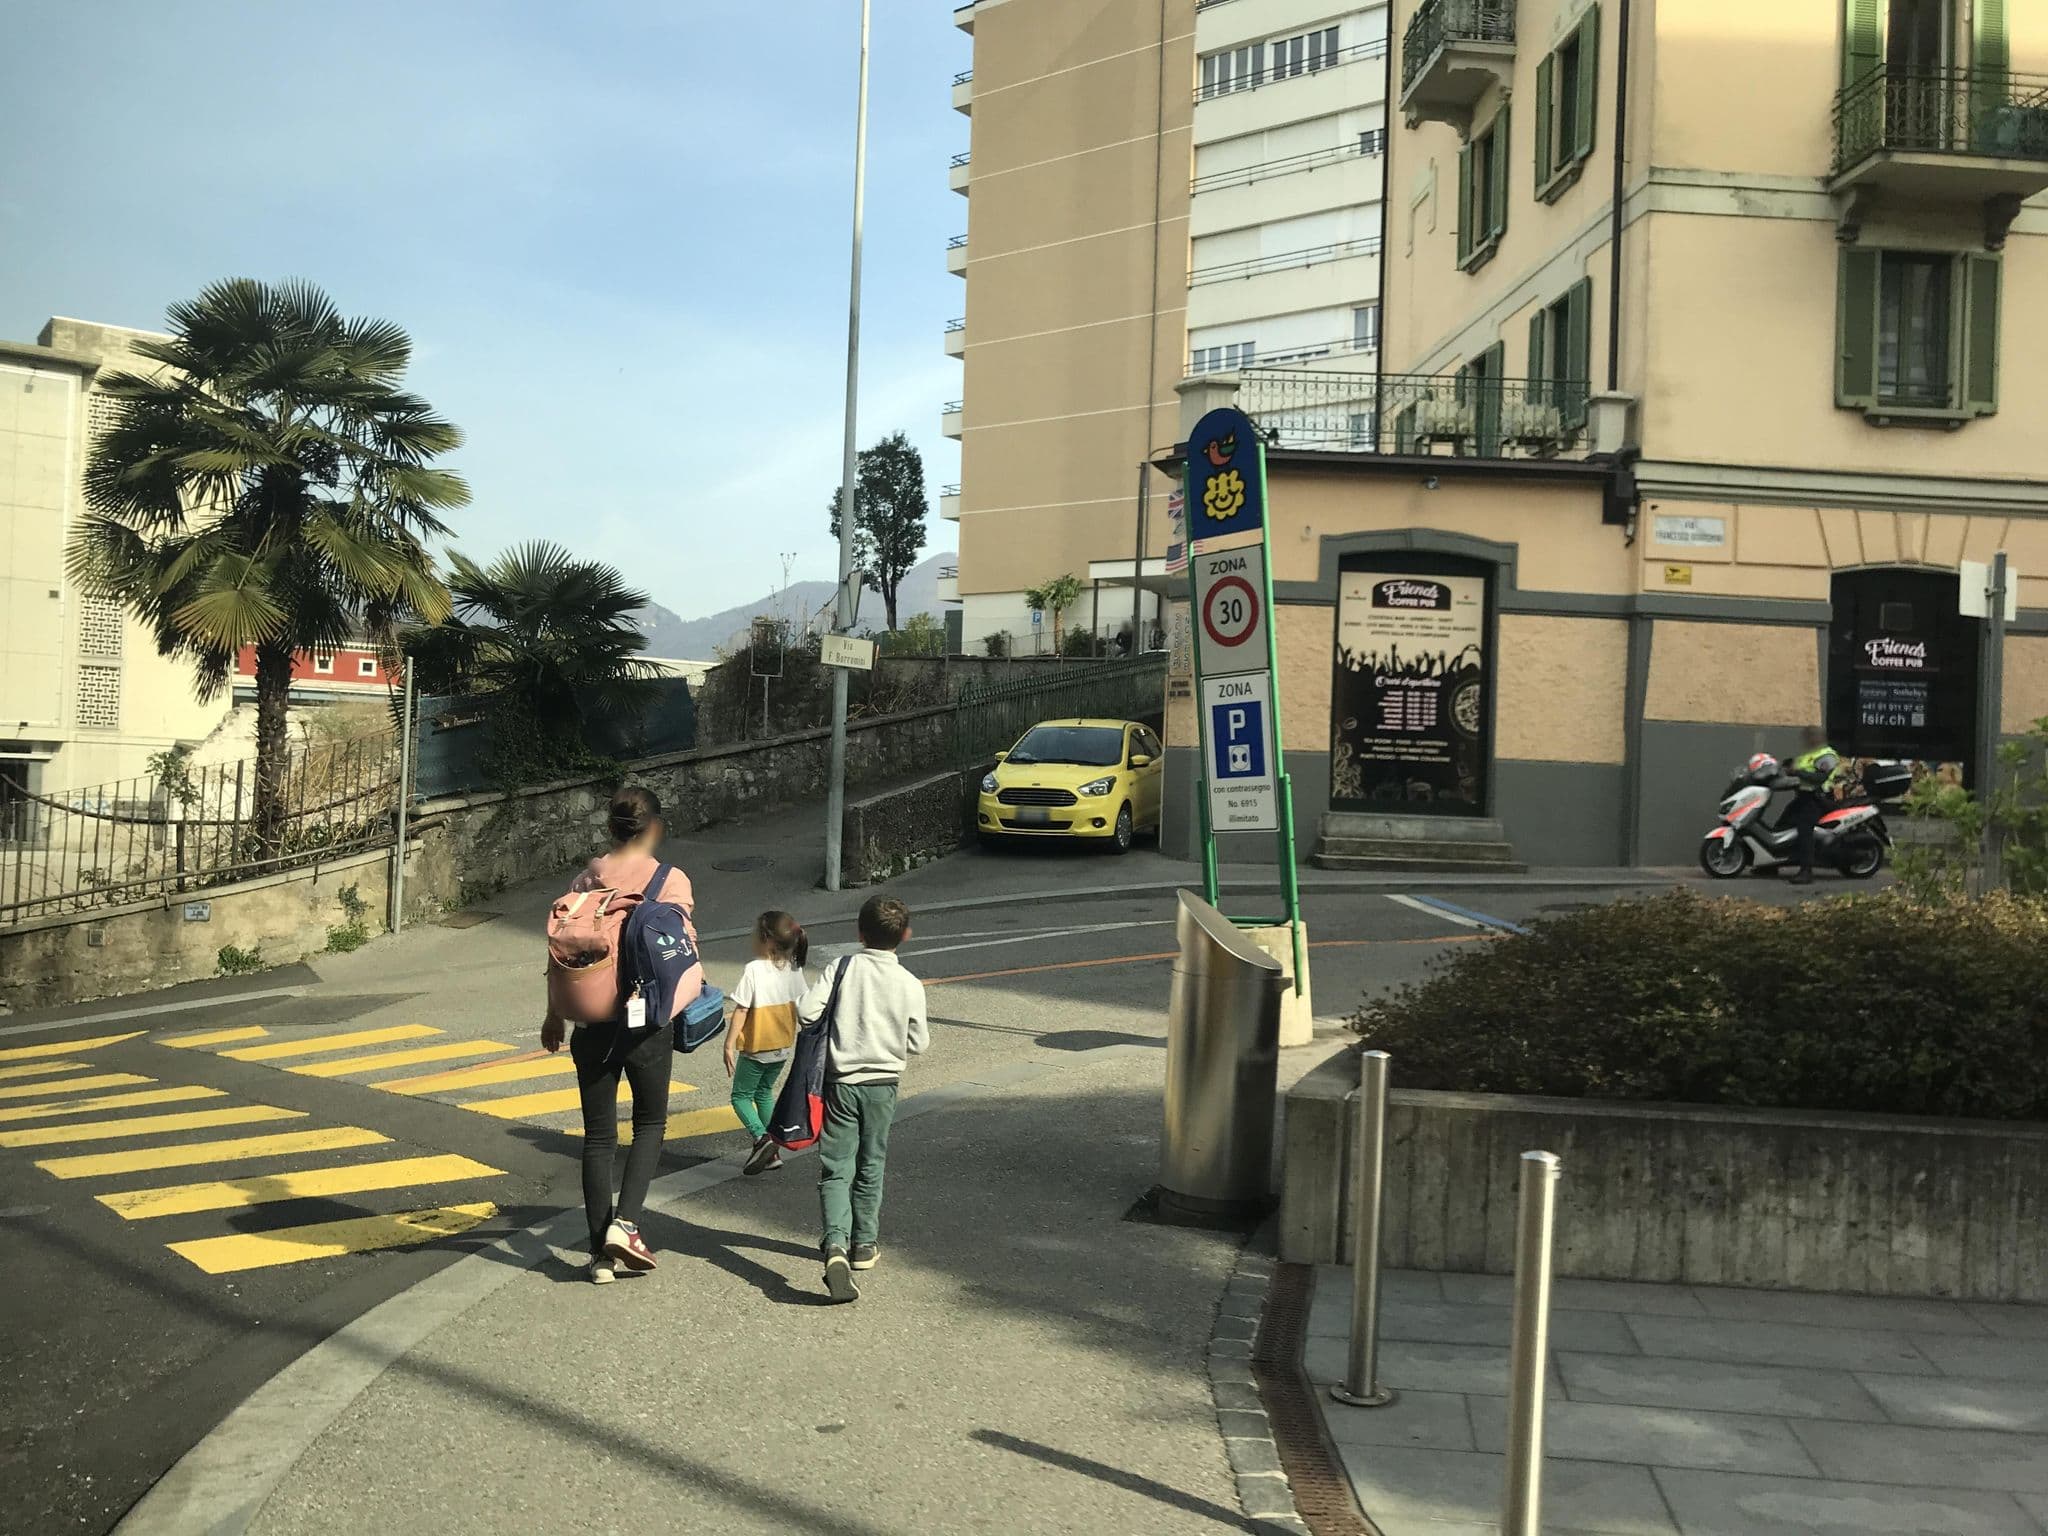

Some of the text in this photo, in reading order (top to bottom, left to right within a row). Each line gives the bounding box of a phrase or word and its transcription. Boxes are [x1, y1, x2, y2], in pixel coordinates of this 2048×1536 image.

[1209, 557, 1248, 575] ZONA
[1382, 581, 1440, 600] Friends
[1388, 598, 1436, 608] COFFEE PUB
[1220, 598, 1243, 625] 30
[843, 639, 853, 651] Via
[1865, 637, 1927, 659] Friends
[1871, 657, 1923, 668] COFFEE PUB
[1218, 682, 1253, 698] ZONA
[1228, 709, 1246, 740] P
[1862, 712, 1906, 726] fsir.ch
[1213, 784, 1272, 794] con contrassegno
[1240, 799, 1258, 808] 6915
